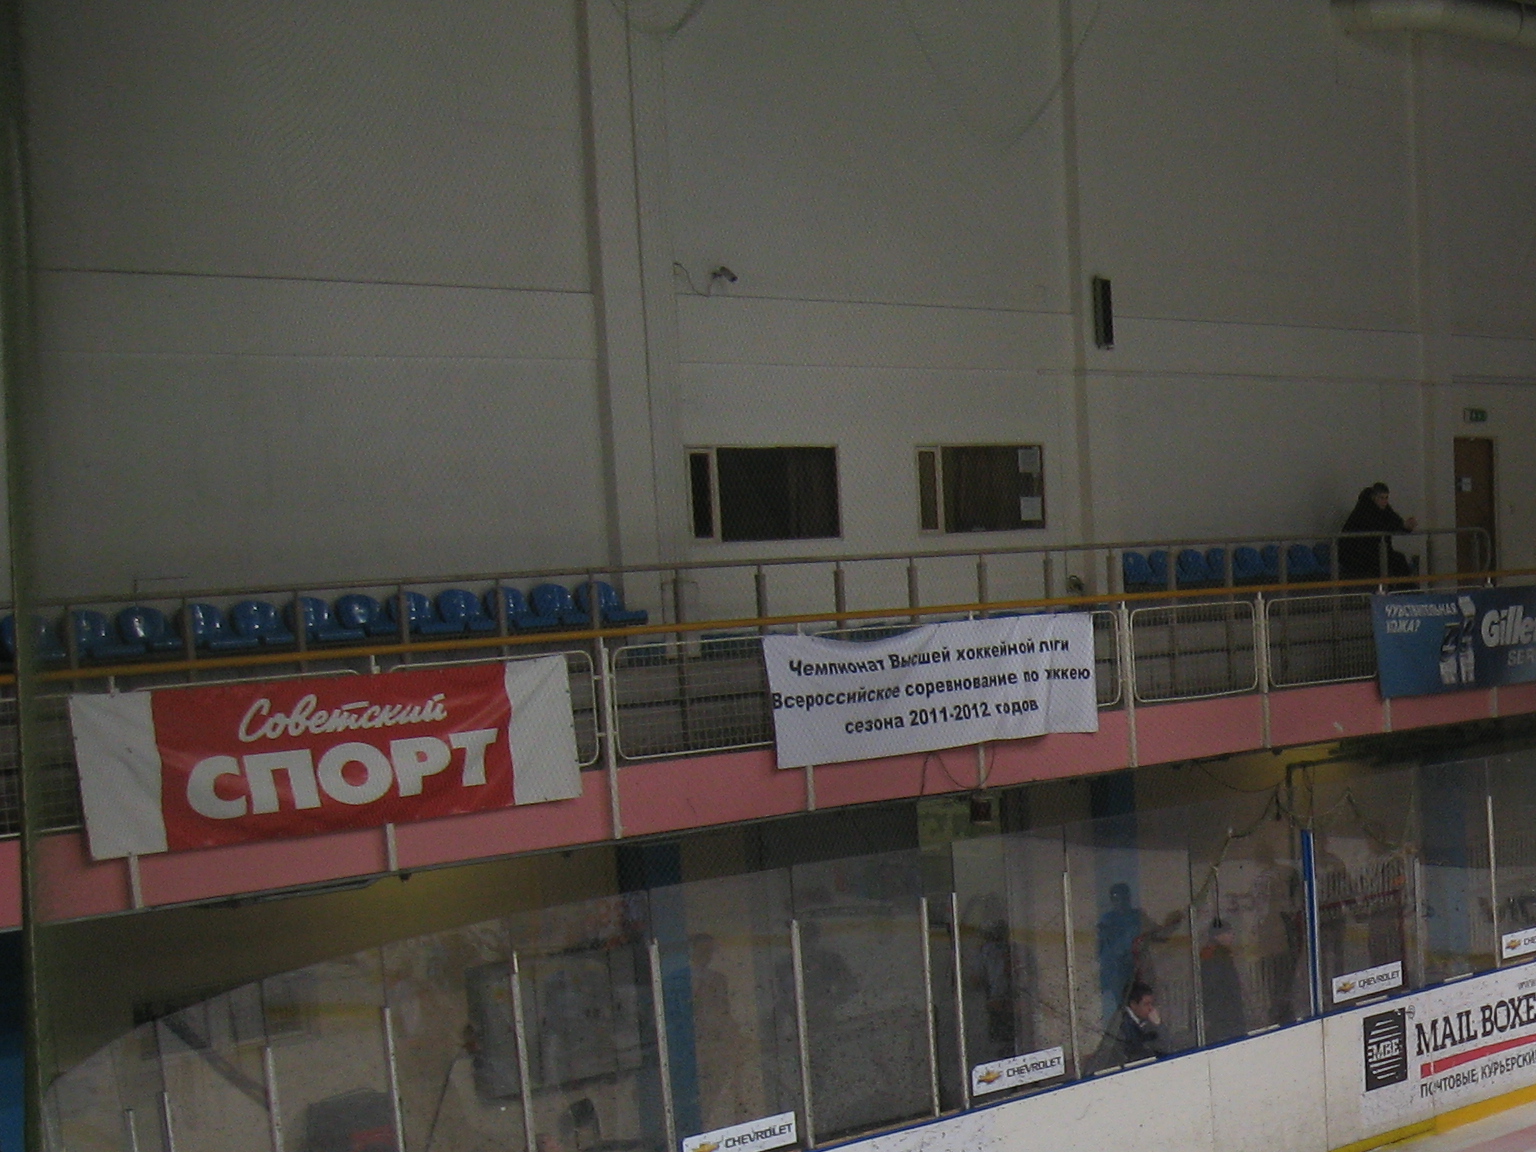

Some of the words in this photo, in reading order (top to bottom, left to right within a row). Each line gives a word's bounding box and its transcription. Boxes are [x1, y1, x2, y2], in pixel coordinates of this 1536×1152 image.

[789, 657, 885, 678] Чемпионат
[888, 648, 951, 671] Высшей
[956, 638, 1036, 663] хоккейной
[772, 683, 901, 711] Всероссийское
[905, 671, 1019, 698] соревнование
[1023, 669, 1039, 683] по
[239, 693, 448, 742] Советский
[844, 713, 905, 734] сезона
[909, 701, 992, 727] 2011-2012
[995, 697, 1039, 716] годов
[186, 728, 498, 820] СПОРТ
[1415, 1009, 1477, 1057] MAIL
[1006, 1057, 1061, 1078] CHEVROLET
[725, 1123, 793, 1148] CHEVROLET
